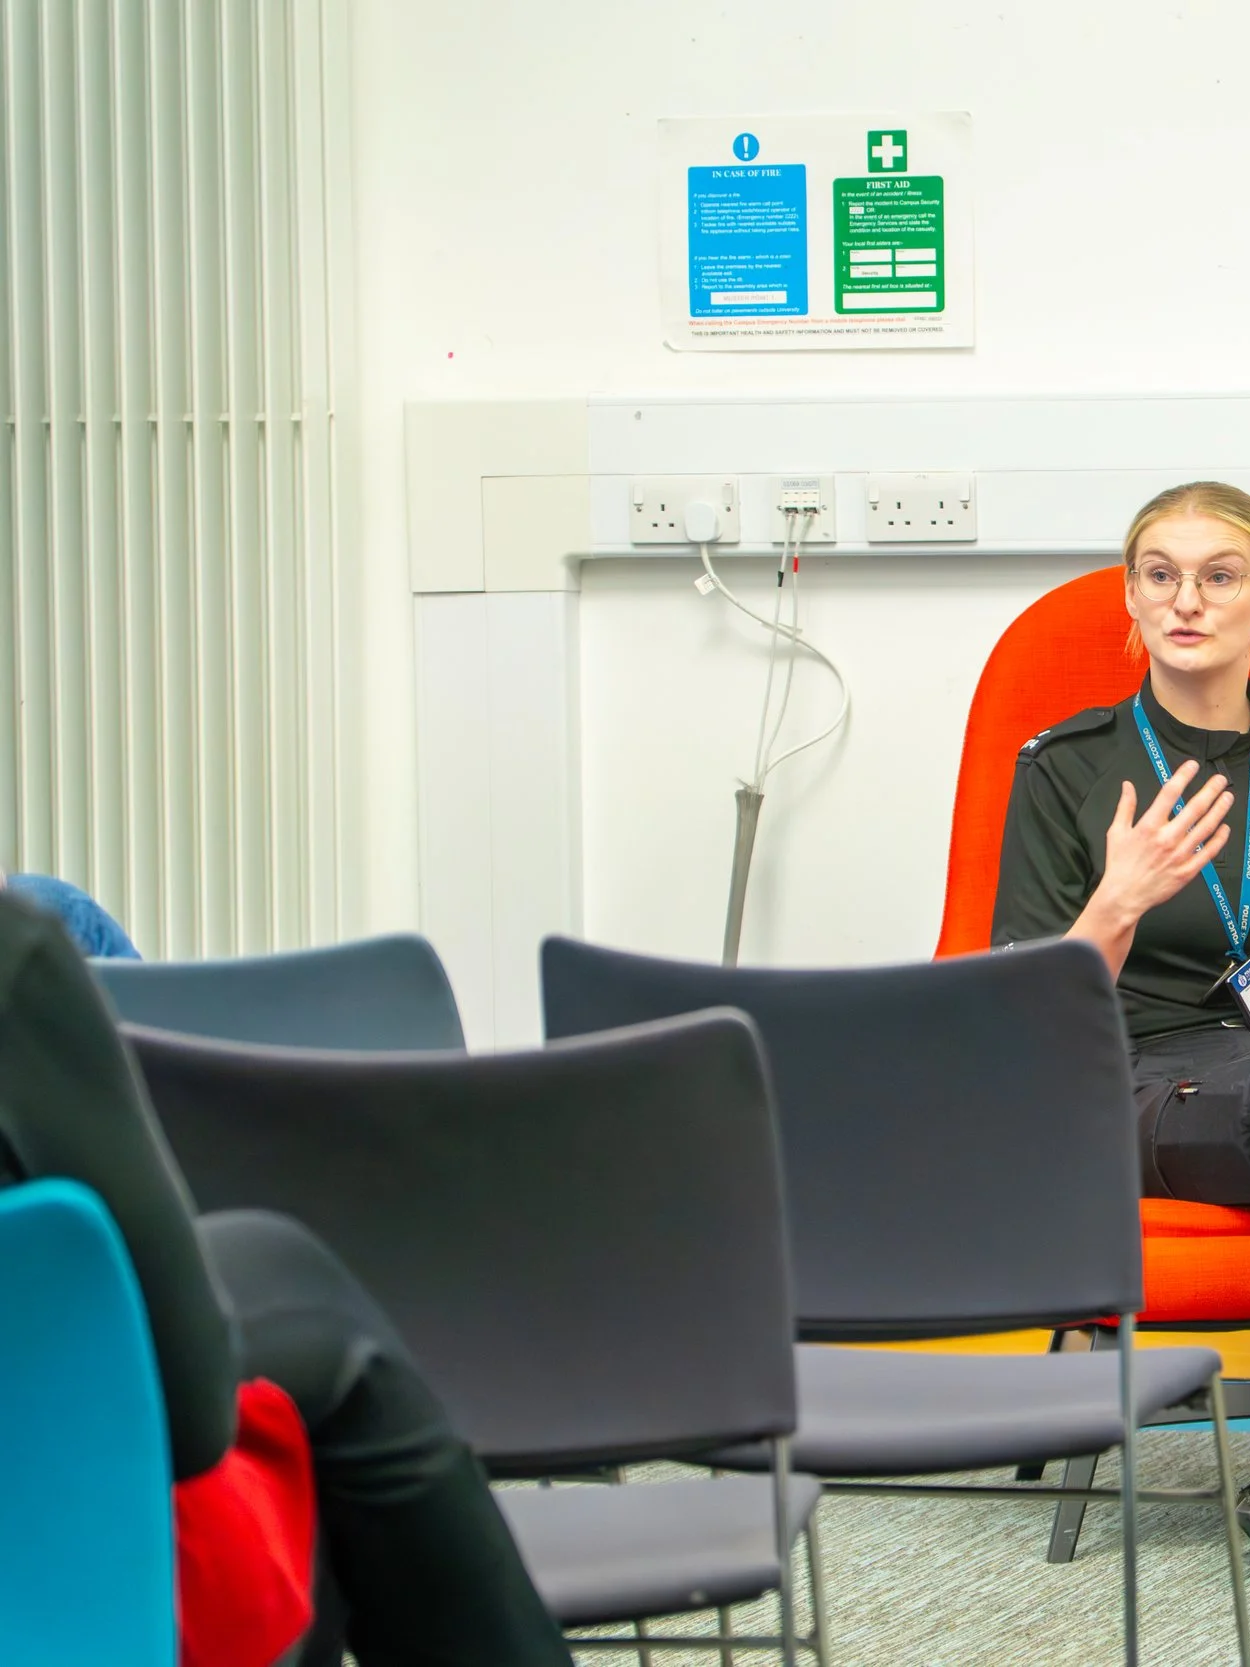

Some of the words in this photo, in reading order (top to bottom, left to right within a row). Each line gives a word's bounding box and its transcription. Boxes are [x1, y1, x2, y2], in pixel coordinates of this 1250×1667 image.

[712, 170, 722, 178] IN
[724, 170, 746, 178] CASE
[747, 169, 759, 177] OF
[762, 168, 782, 176] FIRE
[866, 181, 892, 189] FIRST
[894, 180, 910, 188] AID
[1142, 727, 1160, 759] SCOTLAND
[1156, 759, 1170, 782] POLICE
[1212, 884, 1231, 919] SCOTLAND
[1241, 904, 1250, 930] POLICE
[1227, 920, 1239, 945] POLICE
